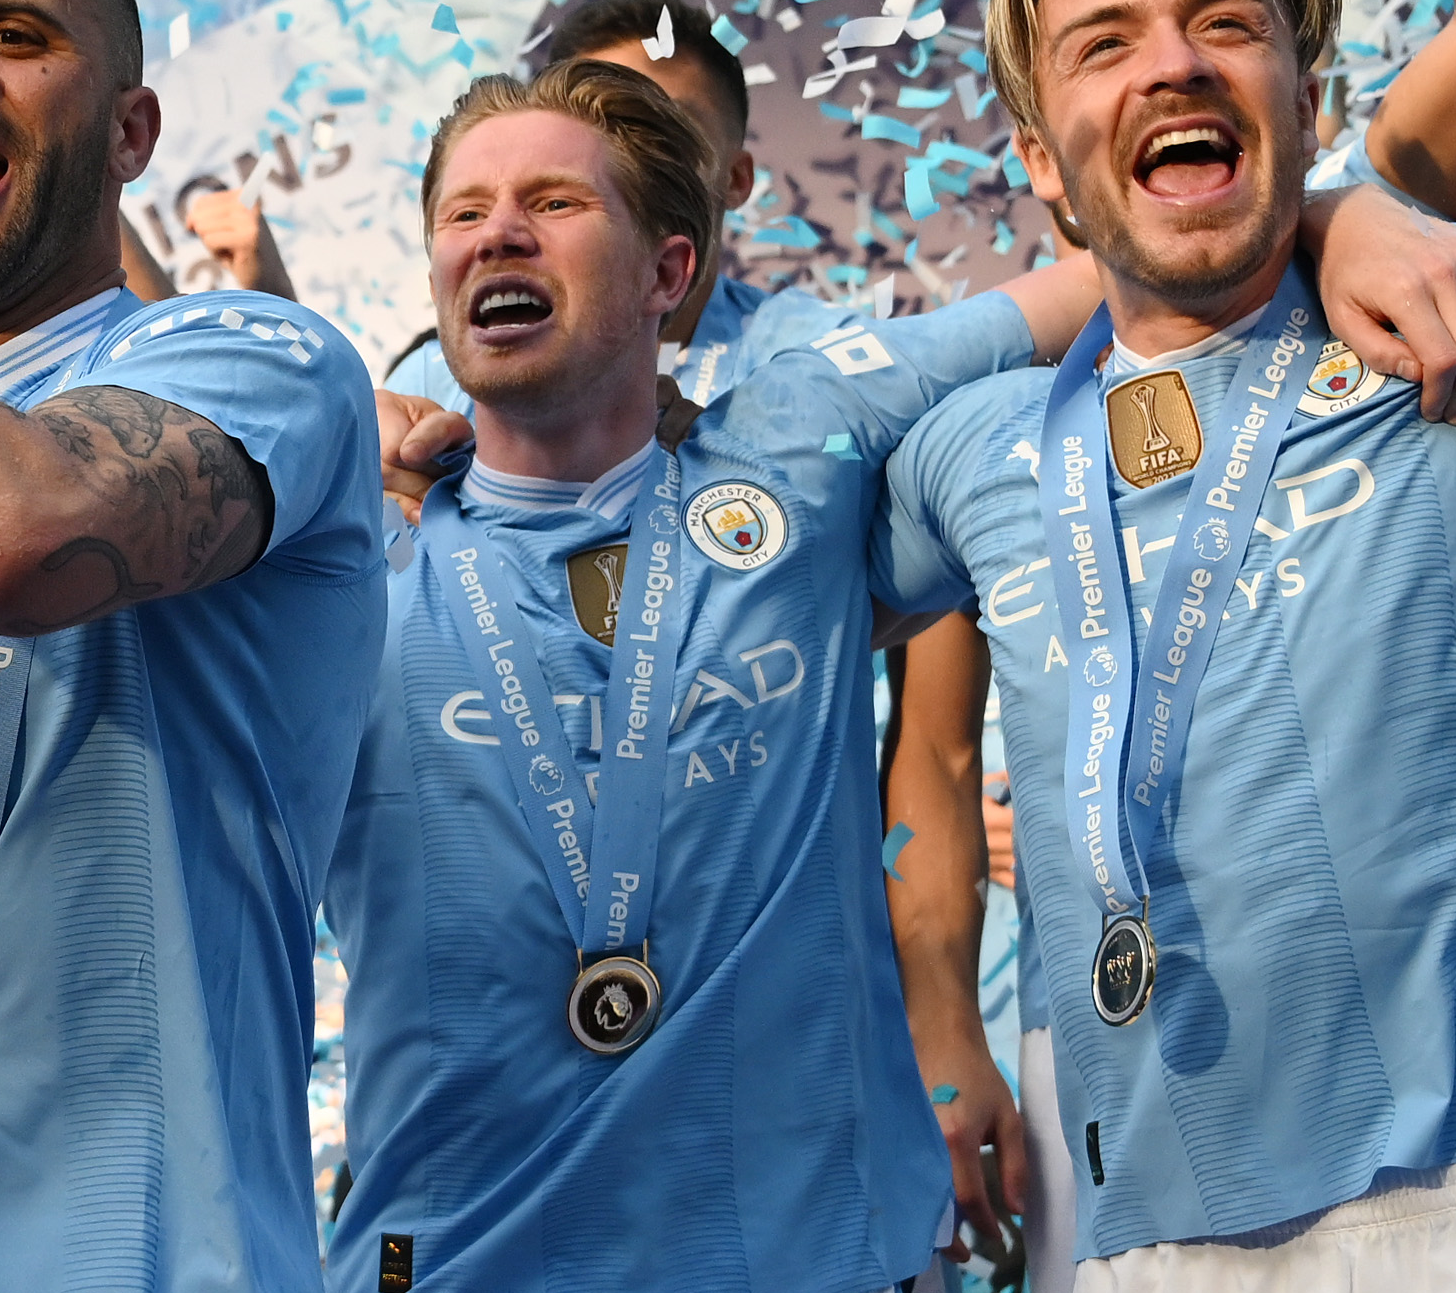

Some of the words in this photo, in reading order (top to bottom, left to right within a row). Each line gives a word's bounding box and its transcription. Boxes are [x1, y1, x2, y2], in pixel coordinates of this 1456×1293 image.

[1139, 447, 1181, 473] FIFA
[1205, 402, 1270, 512] Premier
[1247, 306, 1310, 400] League
[1329, 394, 1362, 414] CITY
[689, 485, 762, 529] MANCHESTER
[1058, 435, 1093, 516] League
[630, 539, 674, 643] League
[741, 547, 770, 569] CITY
[1068, 521, 1110, 641] Premier
[450, 547, 500, 638] Premier
[488, 639, 540, 748] League
[1153, 567, 1212, 686] League
[616, 648, 656, 761] Premier
[1076, 692, 1112, 804] League
[1134, 688, 1175, 809] Premier
[1088, 803, 1127, 915] Premier
